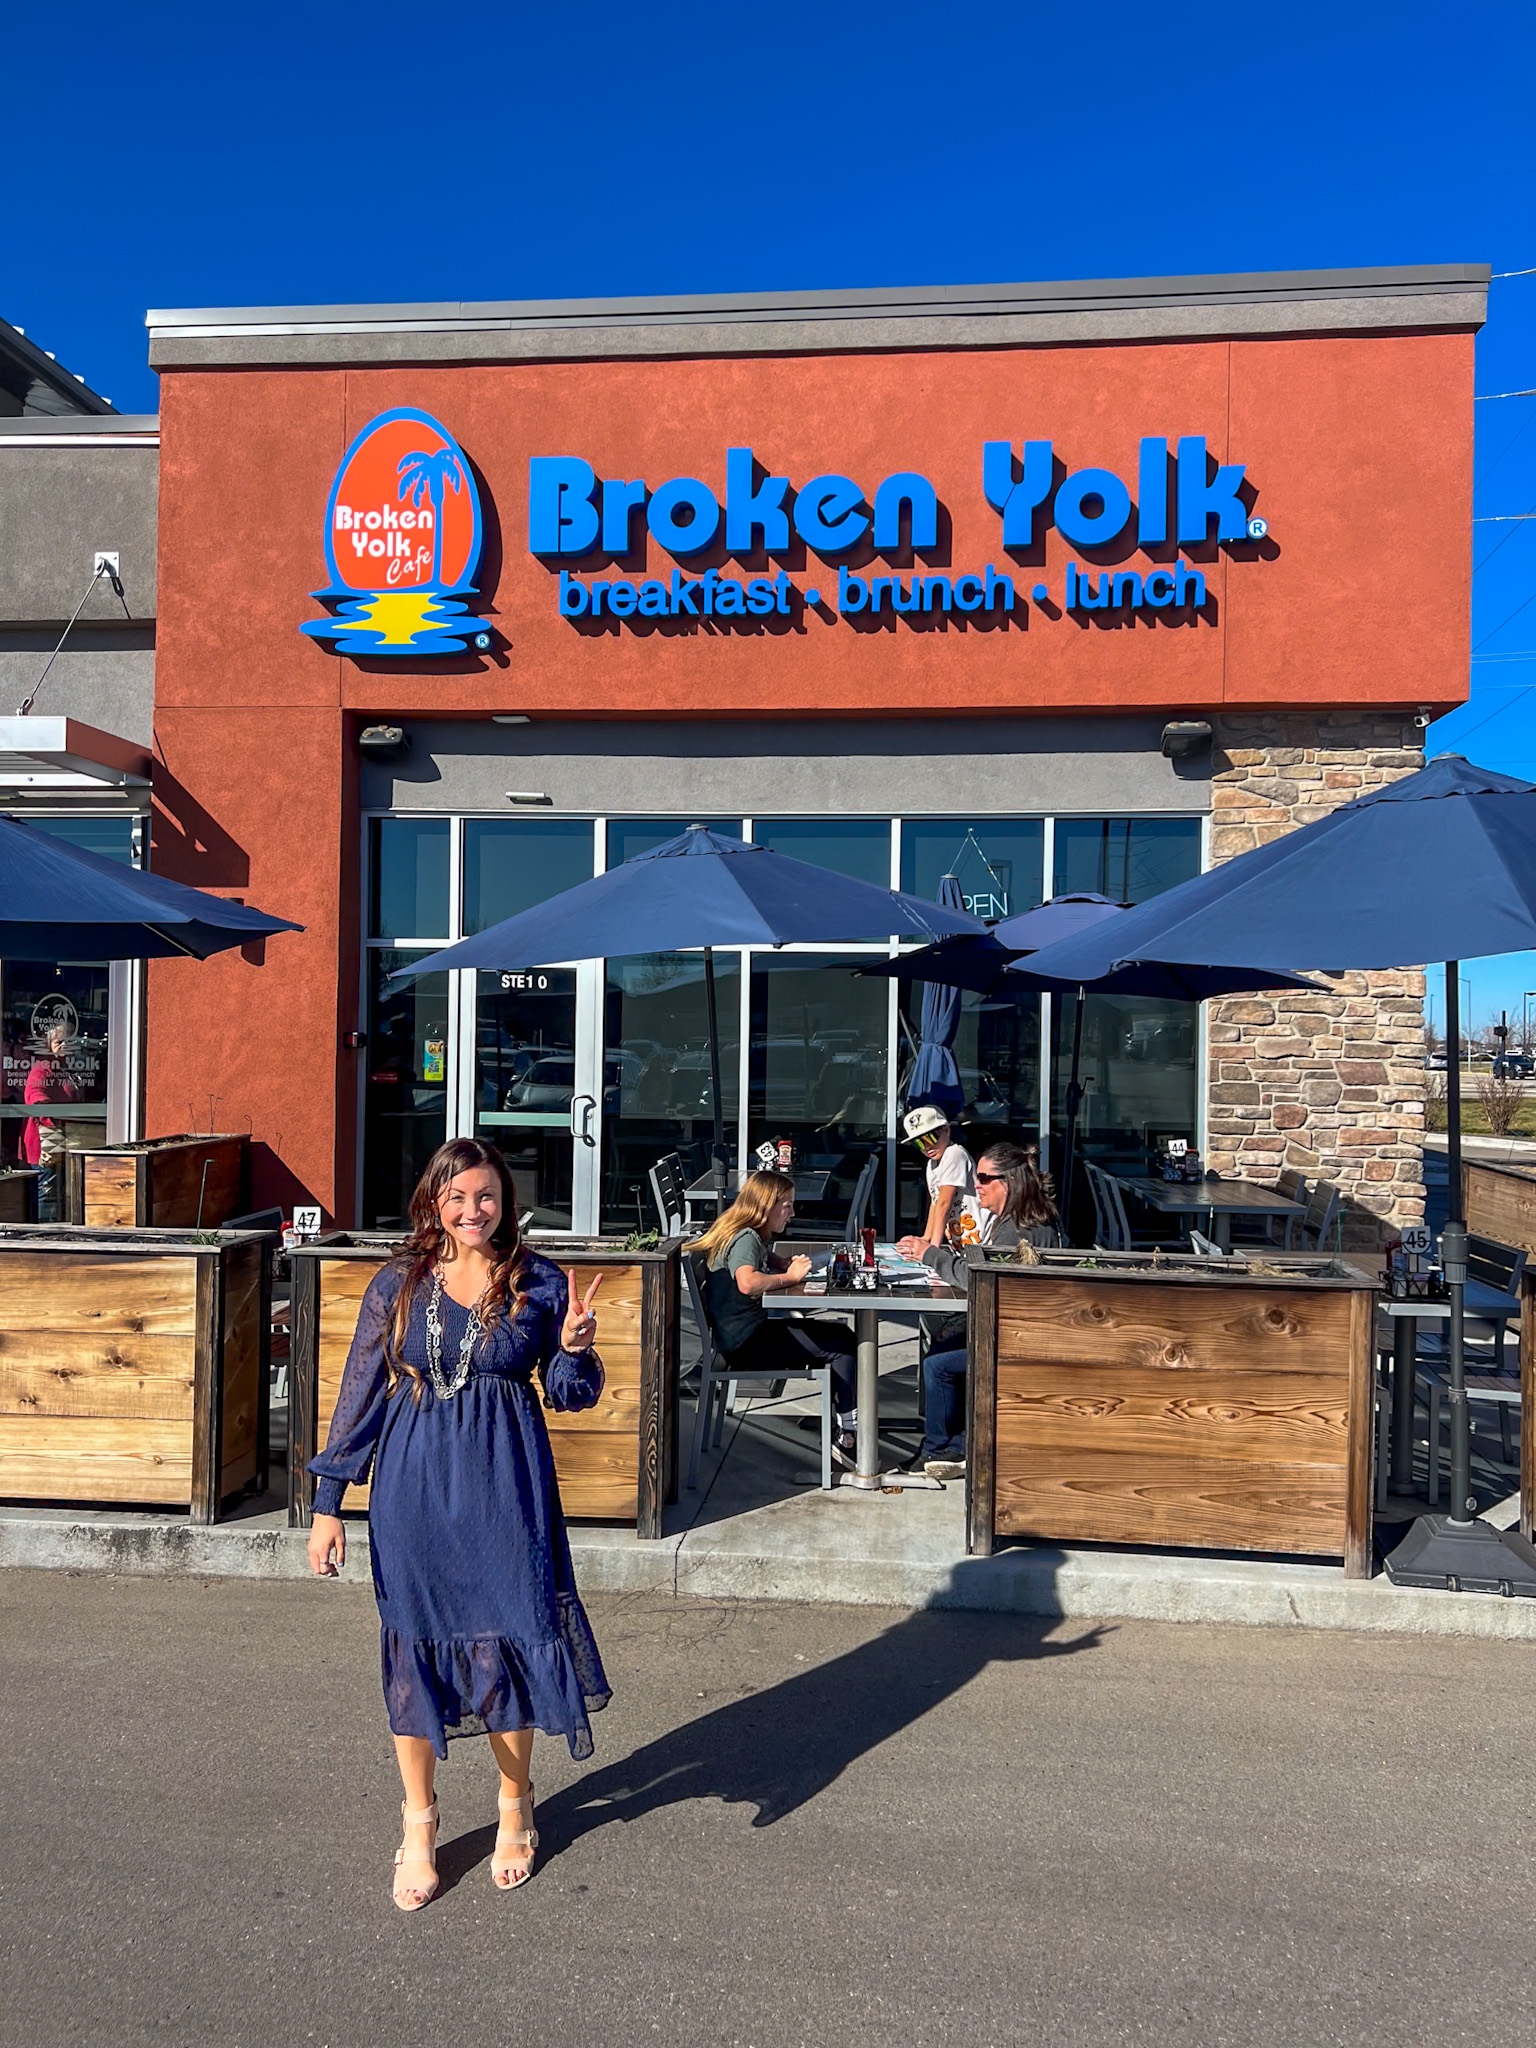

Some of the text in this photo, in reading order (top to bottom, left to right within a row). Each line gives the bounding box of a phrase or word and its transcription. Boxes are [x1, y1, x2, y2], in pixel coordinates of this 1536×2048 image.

[529, 447, 937, 553] Broken
[983, 435, 1247, 547] Yolk
[335, 503, 433, 530] Broken
[351, 531, 411, 557] Yolk
[386, 545, 432, 584] Cafe
[559, 559, 1206, 617] breakfast brunch lunch
[962, 892, 1008, 918] PEN
[65, 1056, 100, 1070] Yolk
[297, 1211, 316, 1229] 47
[1406, 1230, 1427, 1248] 45
